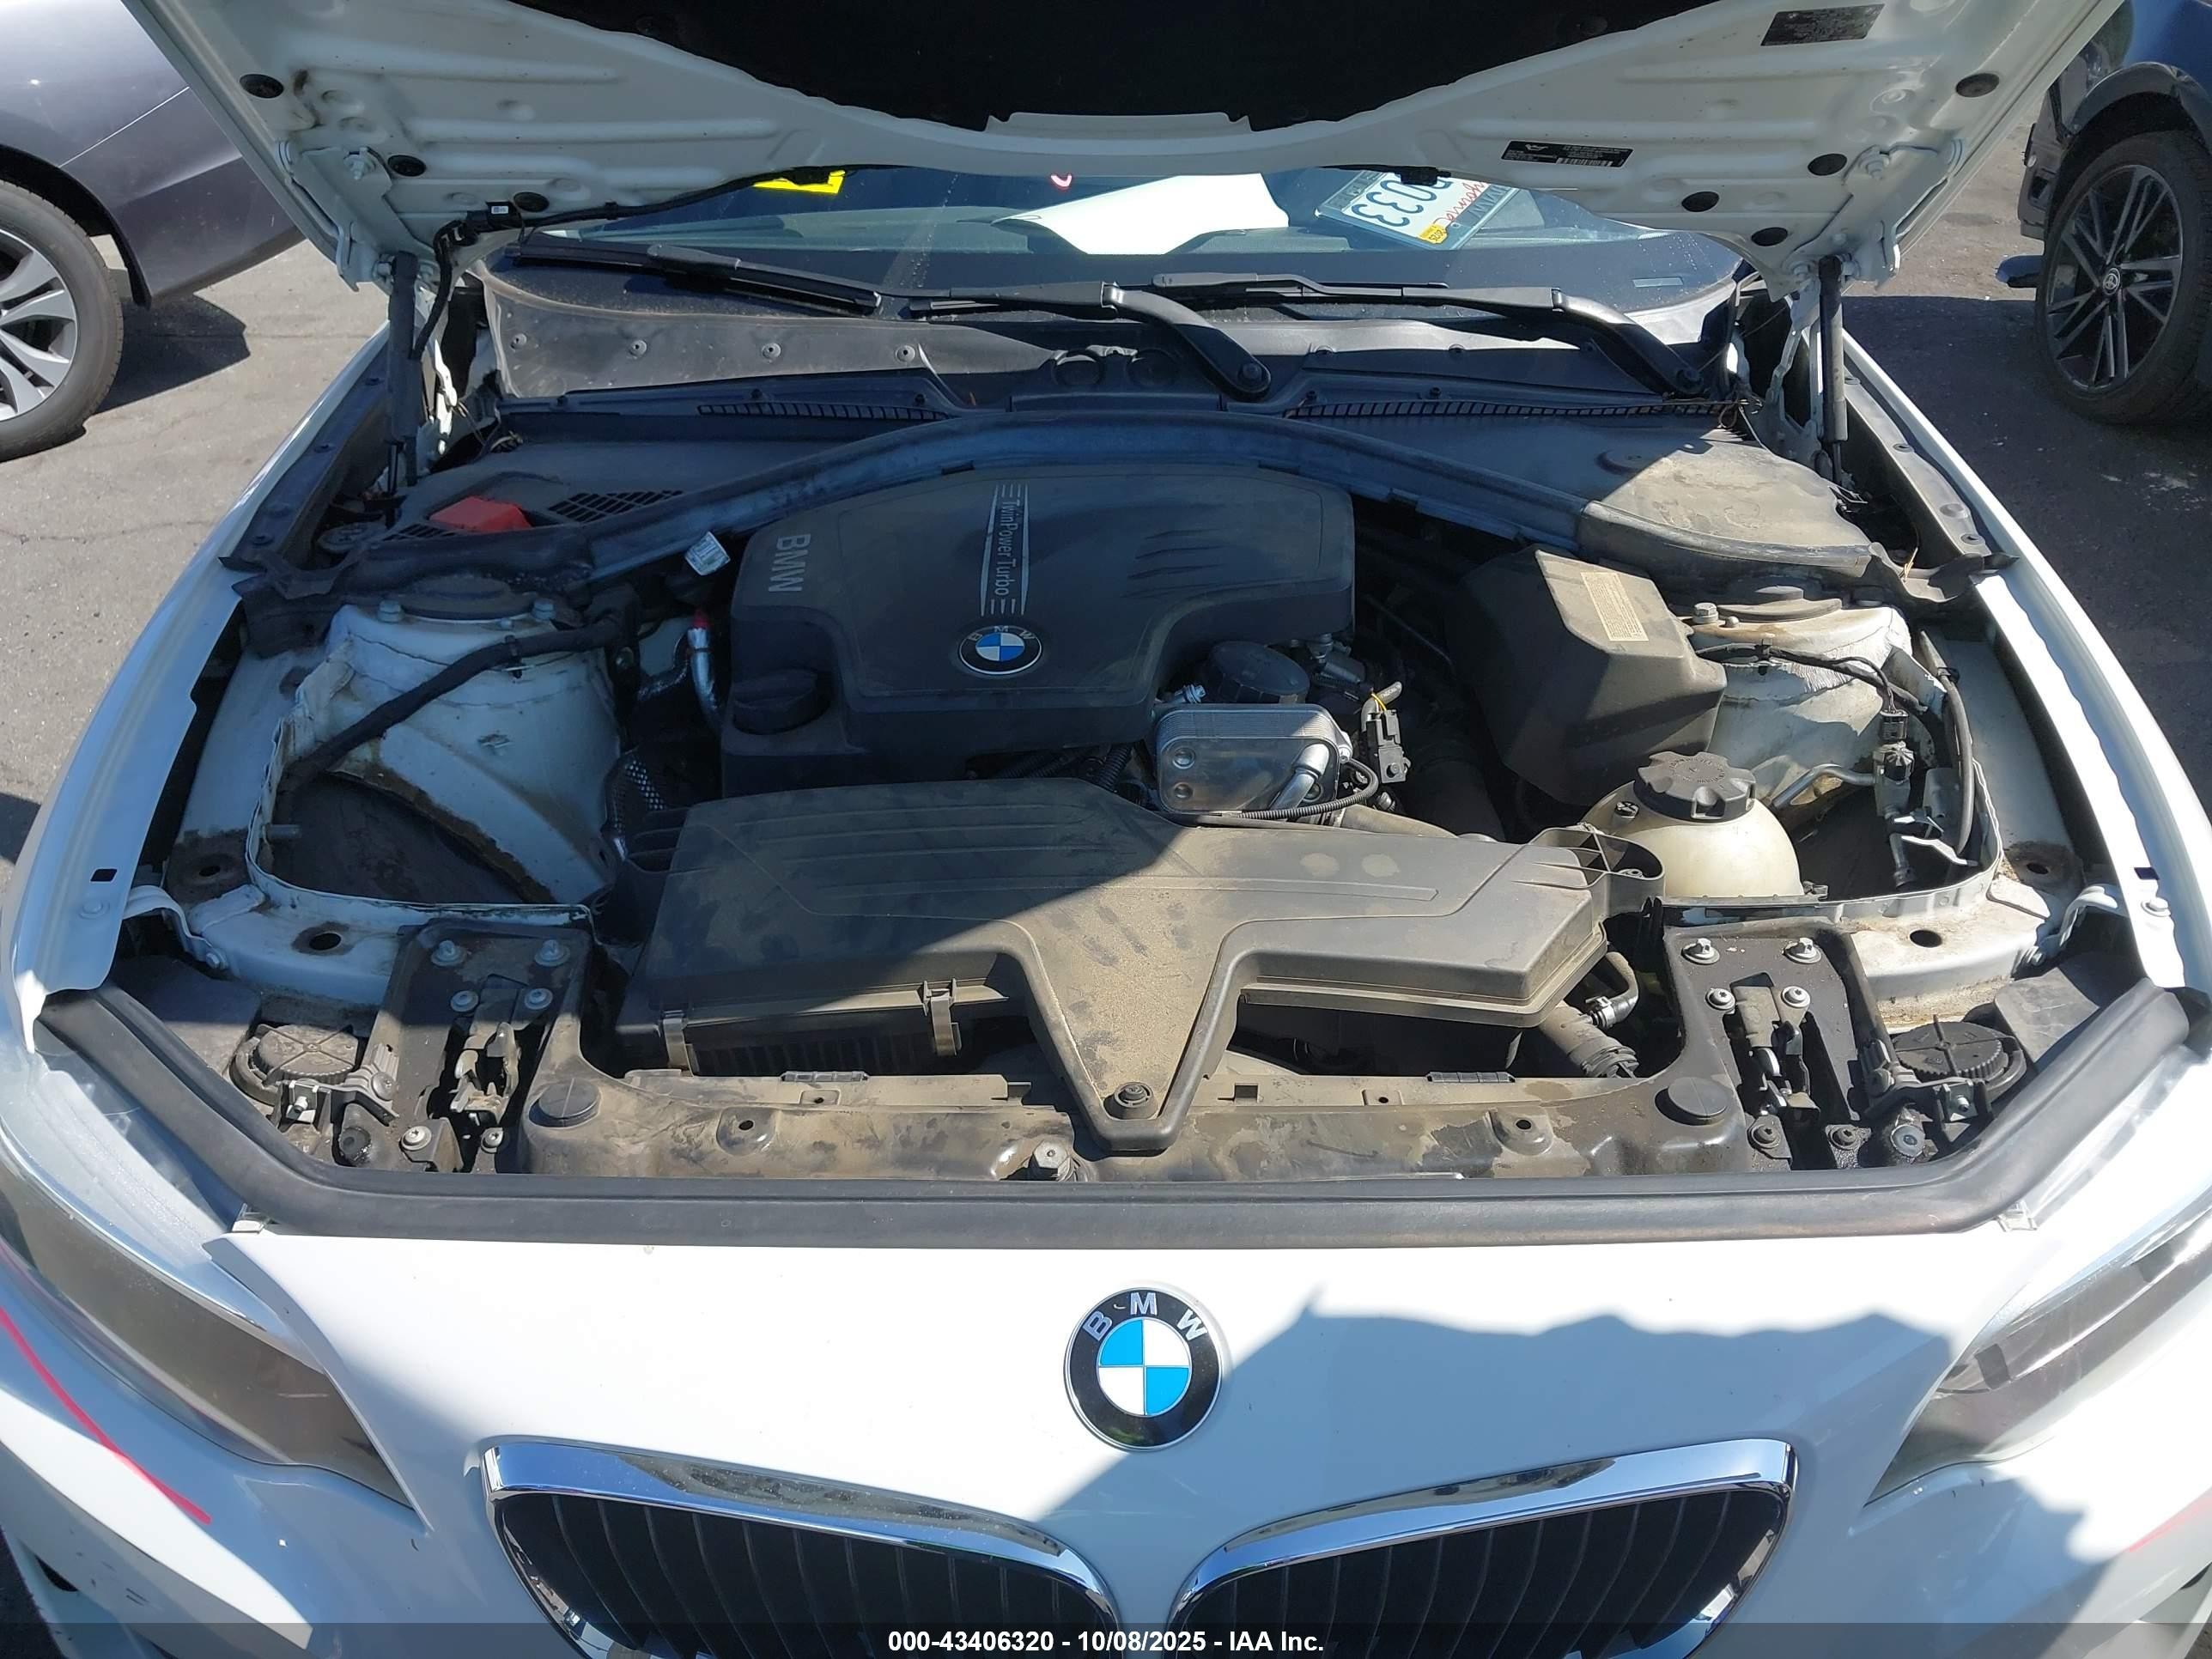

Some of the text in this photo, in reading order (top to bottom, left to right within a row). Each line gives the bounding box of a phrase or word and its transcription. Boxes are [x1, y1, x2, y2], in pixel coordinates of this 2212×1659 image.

[769, 534, 811, 592] BMW
[994, 499, 1020, 596] TwinPower Turbo
[969, 625, 1036, 641] BMW
[1083, 1292, 1208, 1342] BMW
